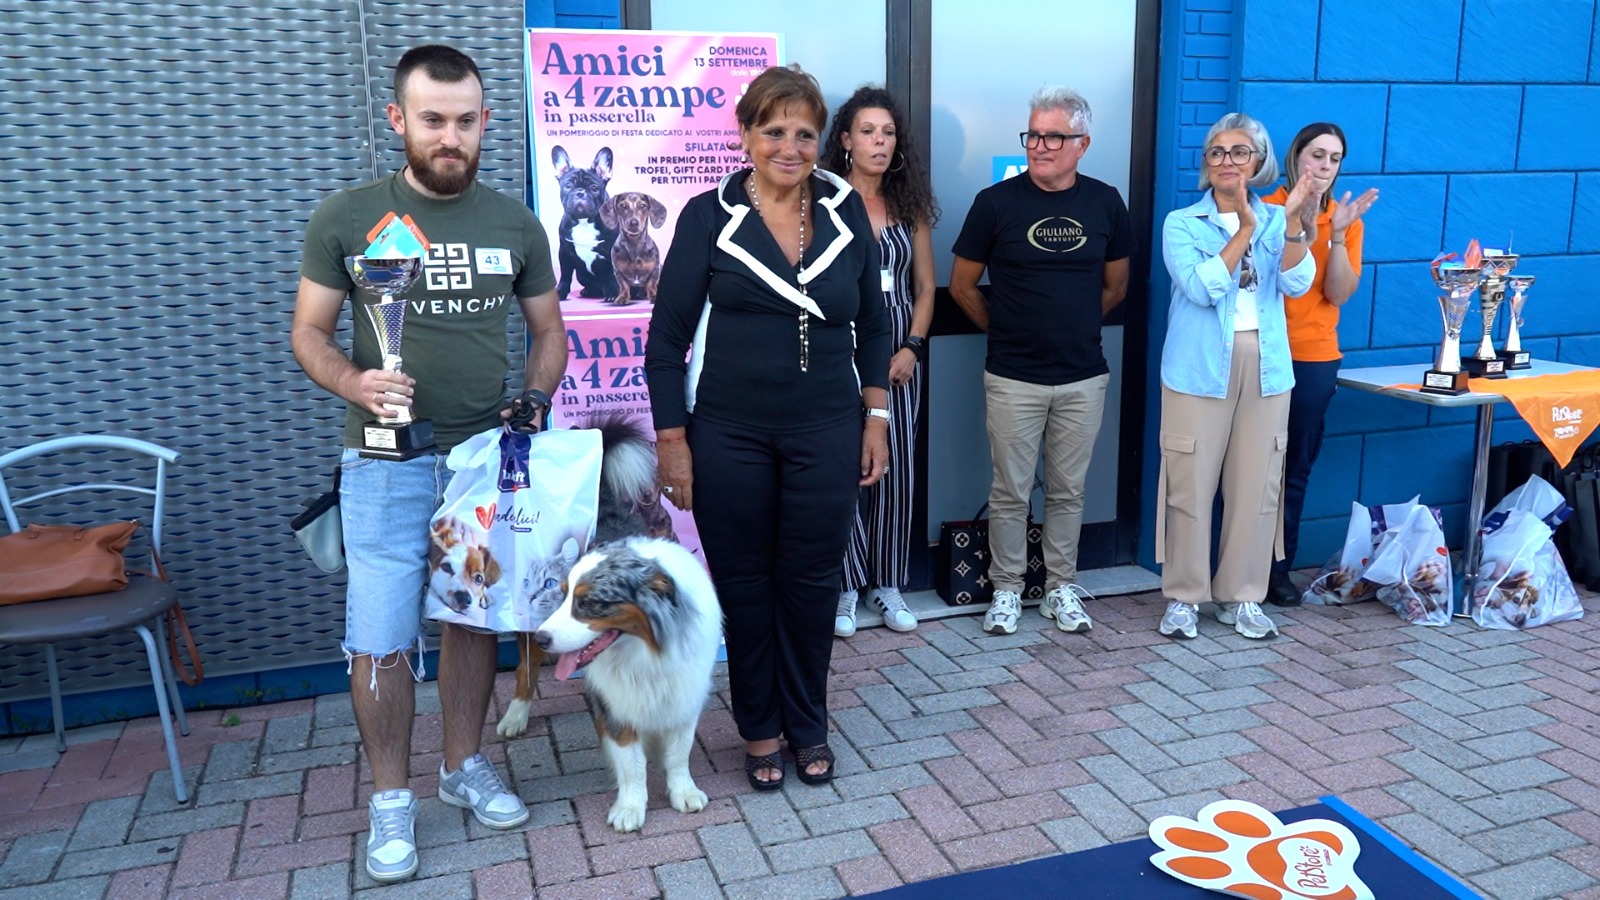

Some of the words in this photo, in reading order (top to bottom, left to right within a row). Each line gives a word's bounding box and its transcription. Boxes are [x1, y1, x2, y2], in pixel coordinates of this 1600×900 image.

[709, 46, 767, 56] DOMENICA
[541, 42, 666, 76] Amici
[694, 58, 705, 67] 13
[708, 58, 768, 67] SETTEMBRE
[543, 90, 561, 107] a
[564, 76, 586, 108] 4
[593, 85, 726, 118] zampe
[544, 109, 562, 123] in
[568, 109, 656, 127] passerella
[547, 129, 558, 137] UN
[559, 129, 610, 137] POMERIGGIO
[611, 129, 620, 137] DI
[621, 129, 643, 137] FESTA
[645, 129, 683, 137] DEDICATO
[696, 129, 722, 137] VOSTRI
[685, 142, 727, 152] SFILATA
[648, 156, 658, 164] IN
[660, 156, 697, 164] PREMIO
[699, 156, 716, 164] PER
[718, 156, 722, 164] I
[634, 166, 672, 175] TROFEI,
[673, 166, 695, 174] GIFT
[697, 166, 724, 174] CARD
[651, 176, 669, 184] PER
[671, 176, 697, 184] TUTTI
[699, 176, 702, 184] I
[704, 176, 722, 184] PAR
[1035, 227, 1083, 237] GIULIANO
[485, 255, 500, 265] 43
[411, 294, 505, 314] VENCHY
[567, 327, 646, 360] Ami
[561, 374, 577, 390] a
[581, 360, 602, 389] 4
[609, 366, 647, 388] za
[561, 392, 579, 405] in
[585, 391, 649, 408] passere
[1294, 845, 1330, 889] PetStore
